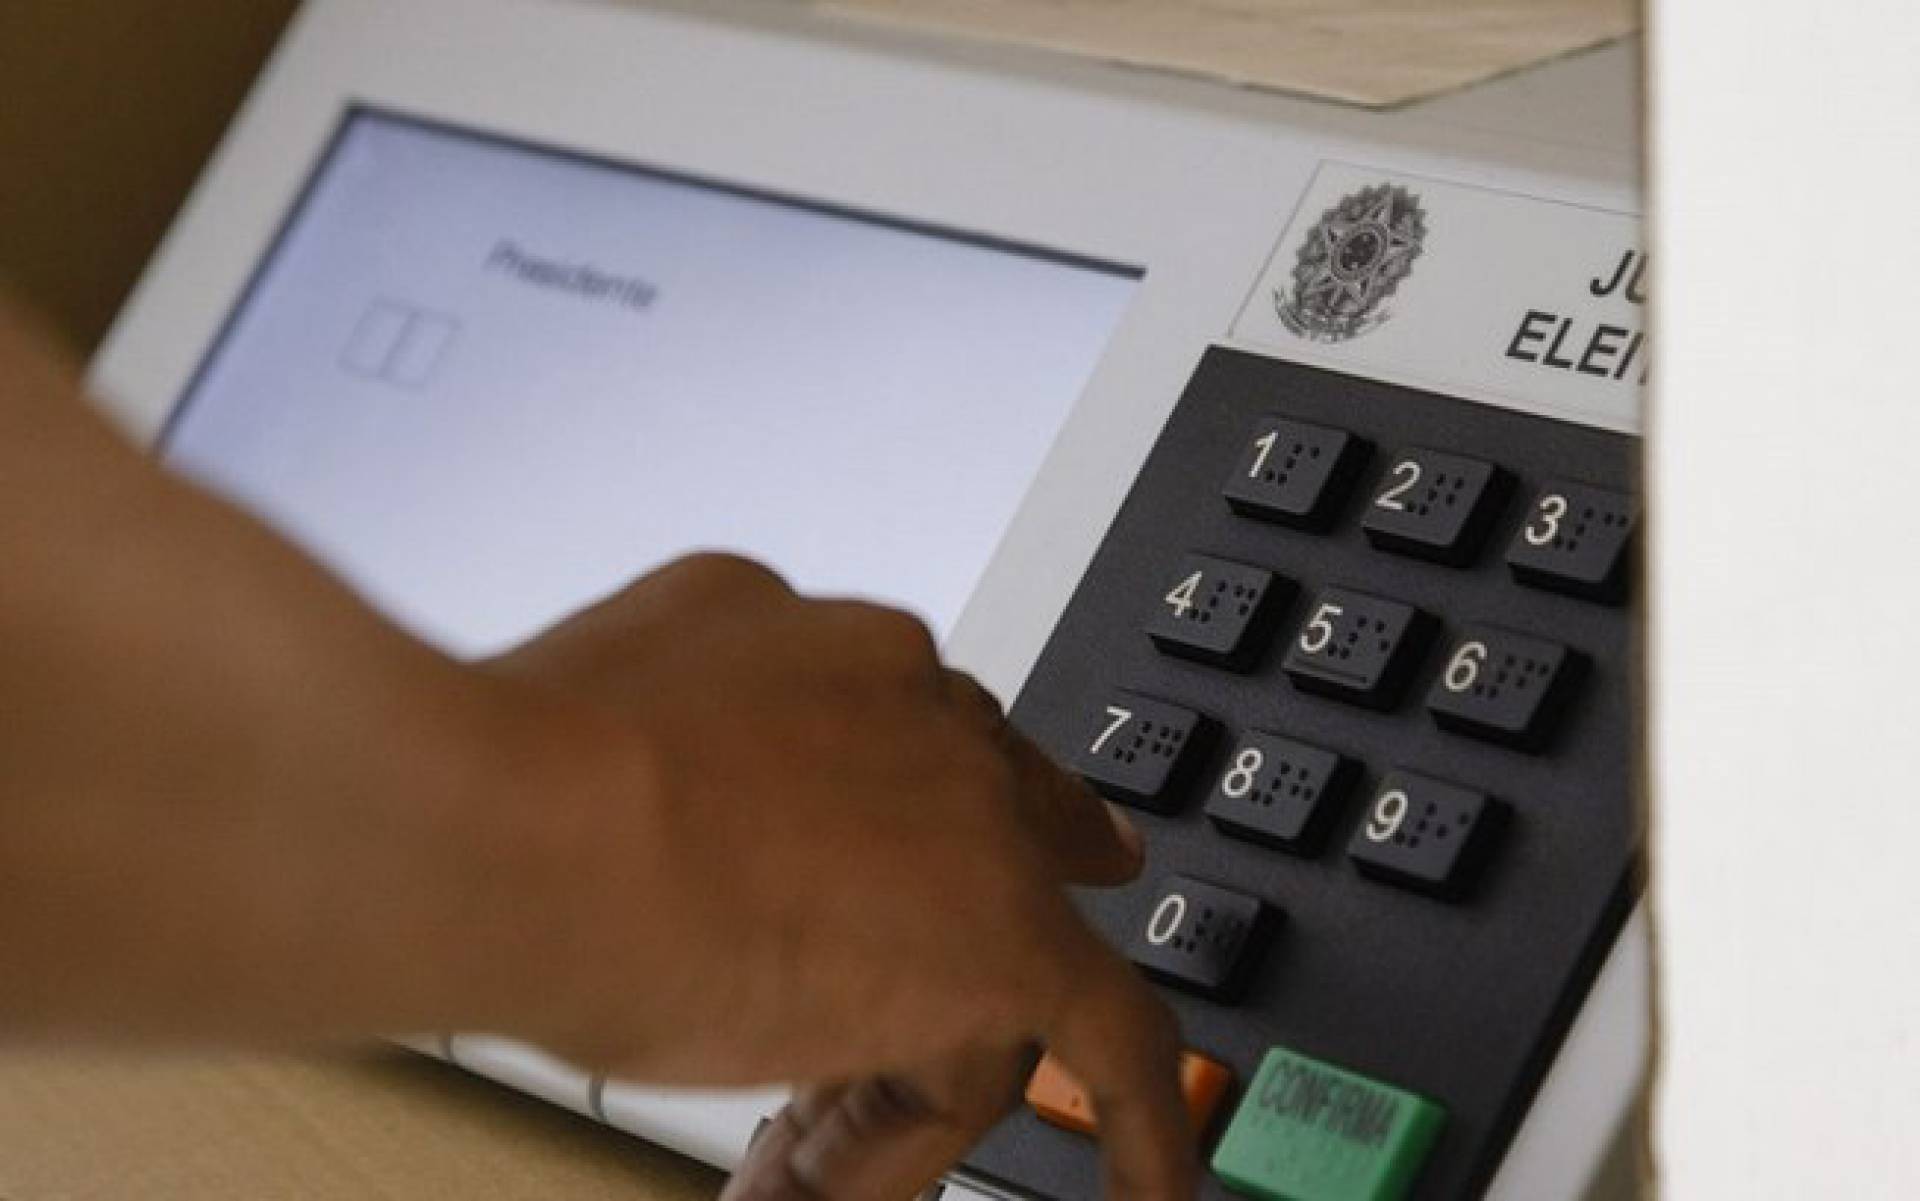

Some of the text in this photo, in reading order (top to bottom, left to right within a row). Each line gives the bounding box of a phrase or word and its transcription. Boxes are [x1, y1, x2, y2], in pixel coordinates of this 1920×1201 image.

[1505, 309, 1648, 386] ELEI
[1249, 432, 1278, 477] 1
[1376, 461, 1421, 509] 2
[1525, 495, 1568, 545] 3
[1164, 571, 1202, 616] 4
[1300, 603, 1343, 653] 5
[1444, 641, 1487, 692] 6
[1090, 706, 1131, 754] 7
[1222, 748, 1263, 797] 8
[1366, 790, 1408, 842] 9
[1147, 894, 1186, 944] 0
[1258, 1057, 1400, 1148] CONFIRMA
